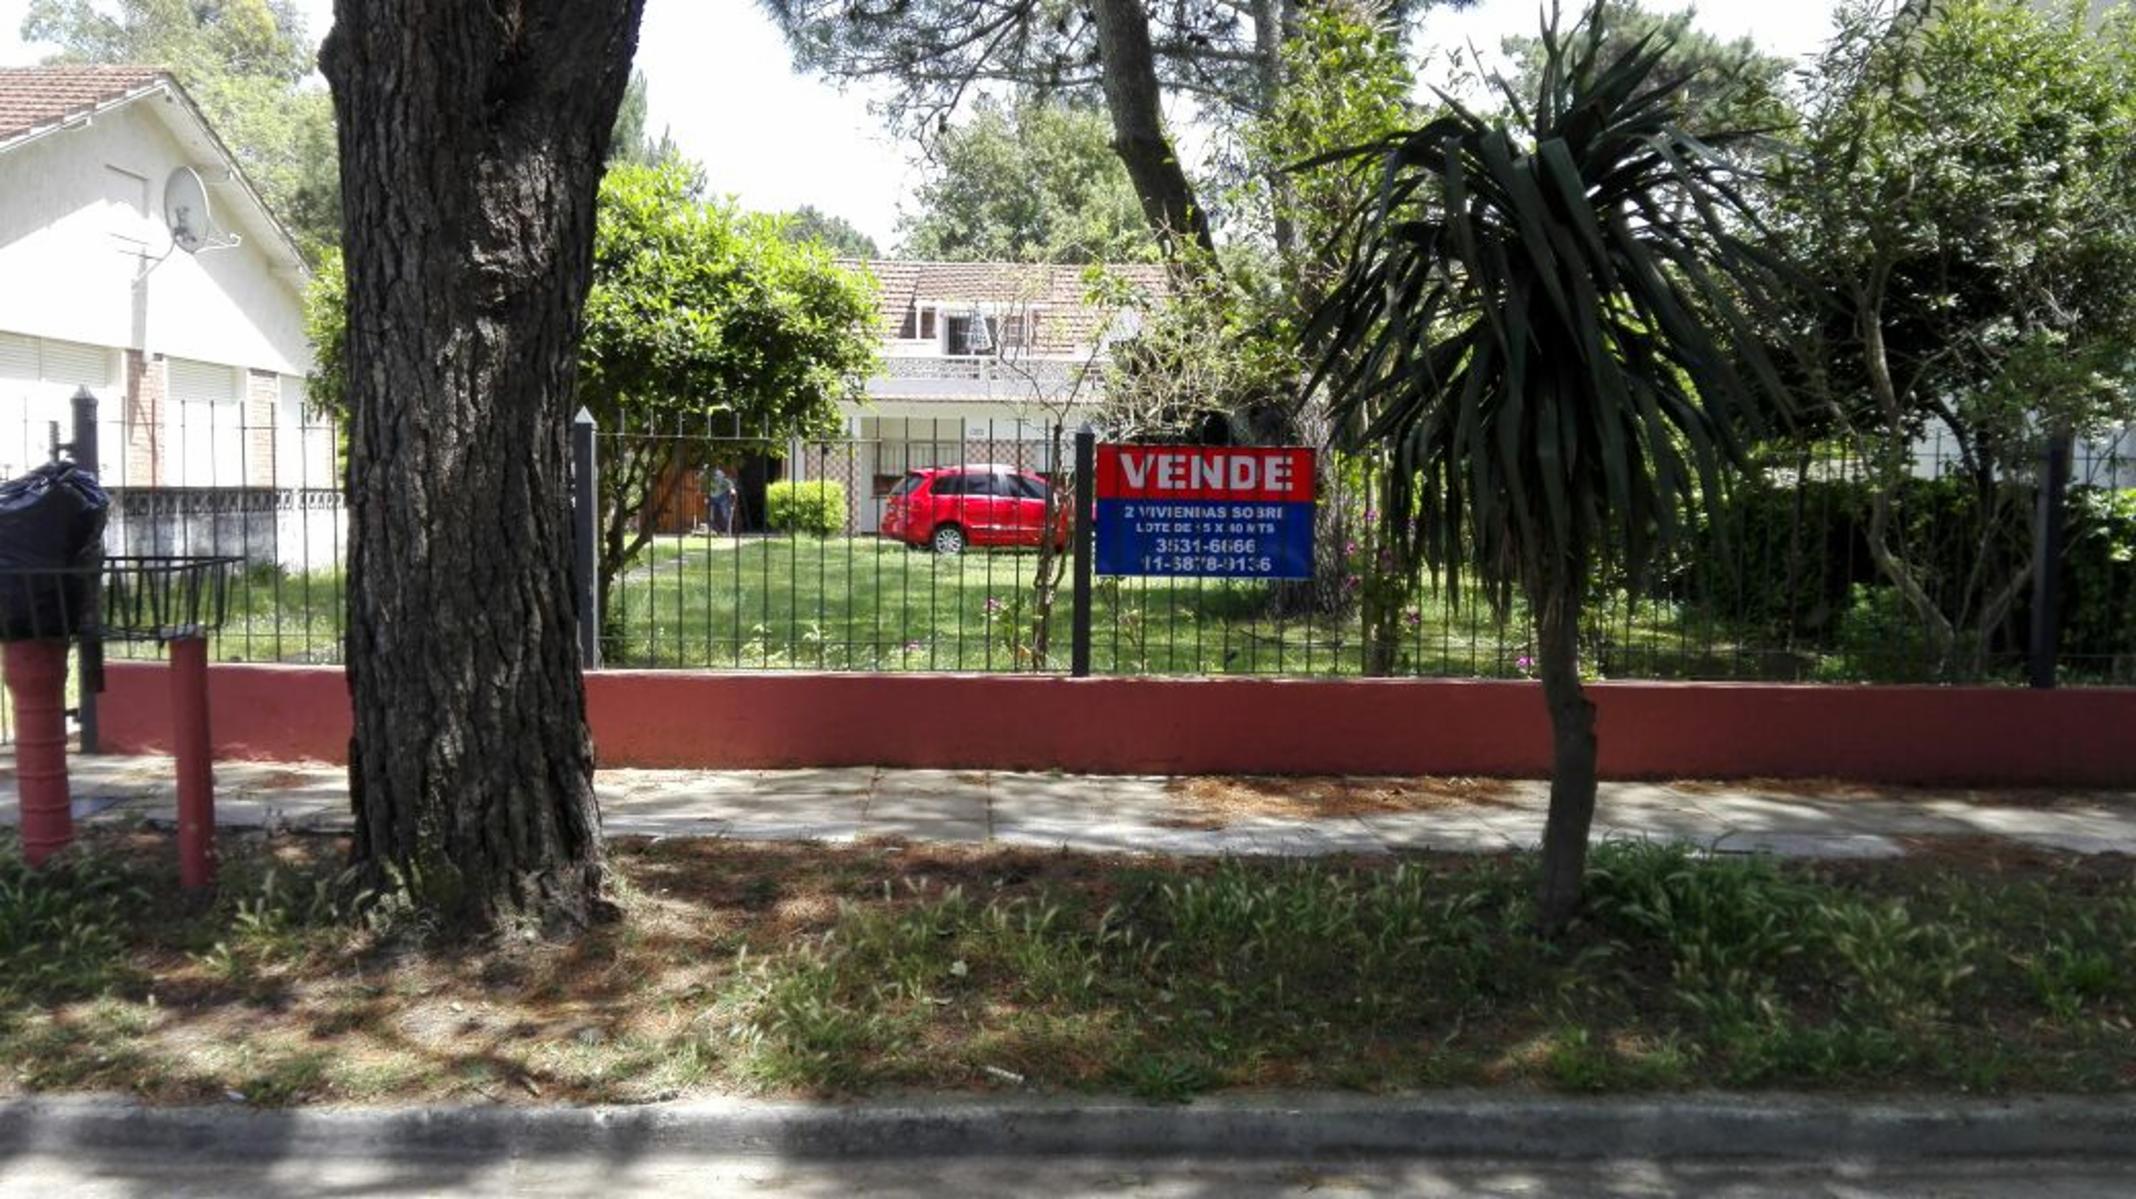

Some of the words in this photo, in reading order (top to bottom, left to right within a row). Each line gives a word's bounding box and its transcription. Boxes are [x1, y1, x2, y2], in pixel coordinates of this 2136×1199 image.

[1119, 453, 1294, 491] VENDE
[1124, 506, 1135, 519] 2
[1138, 506, 1227, 519] VIVIENDAS
[1136, 522, 1171, 533] LOTE
[1174, 523, 1193, 533] DE
[1215, 523, 1224, 533] X
[1155, 538, 1257, 554] 3531-6666
